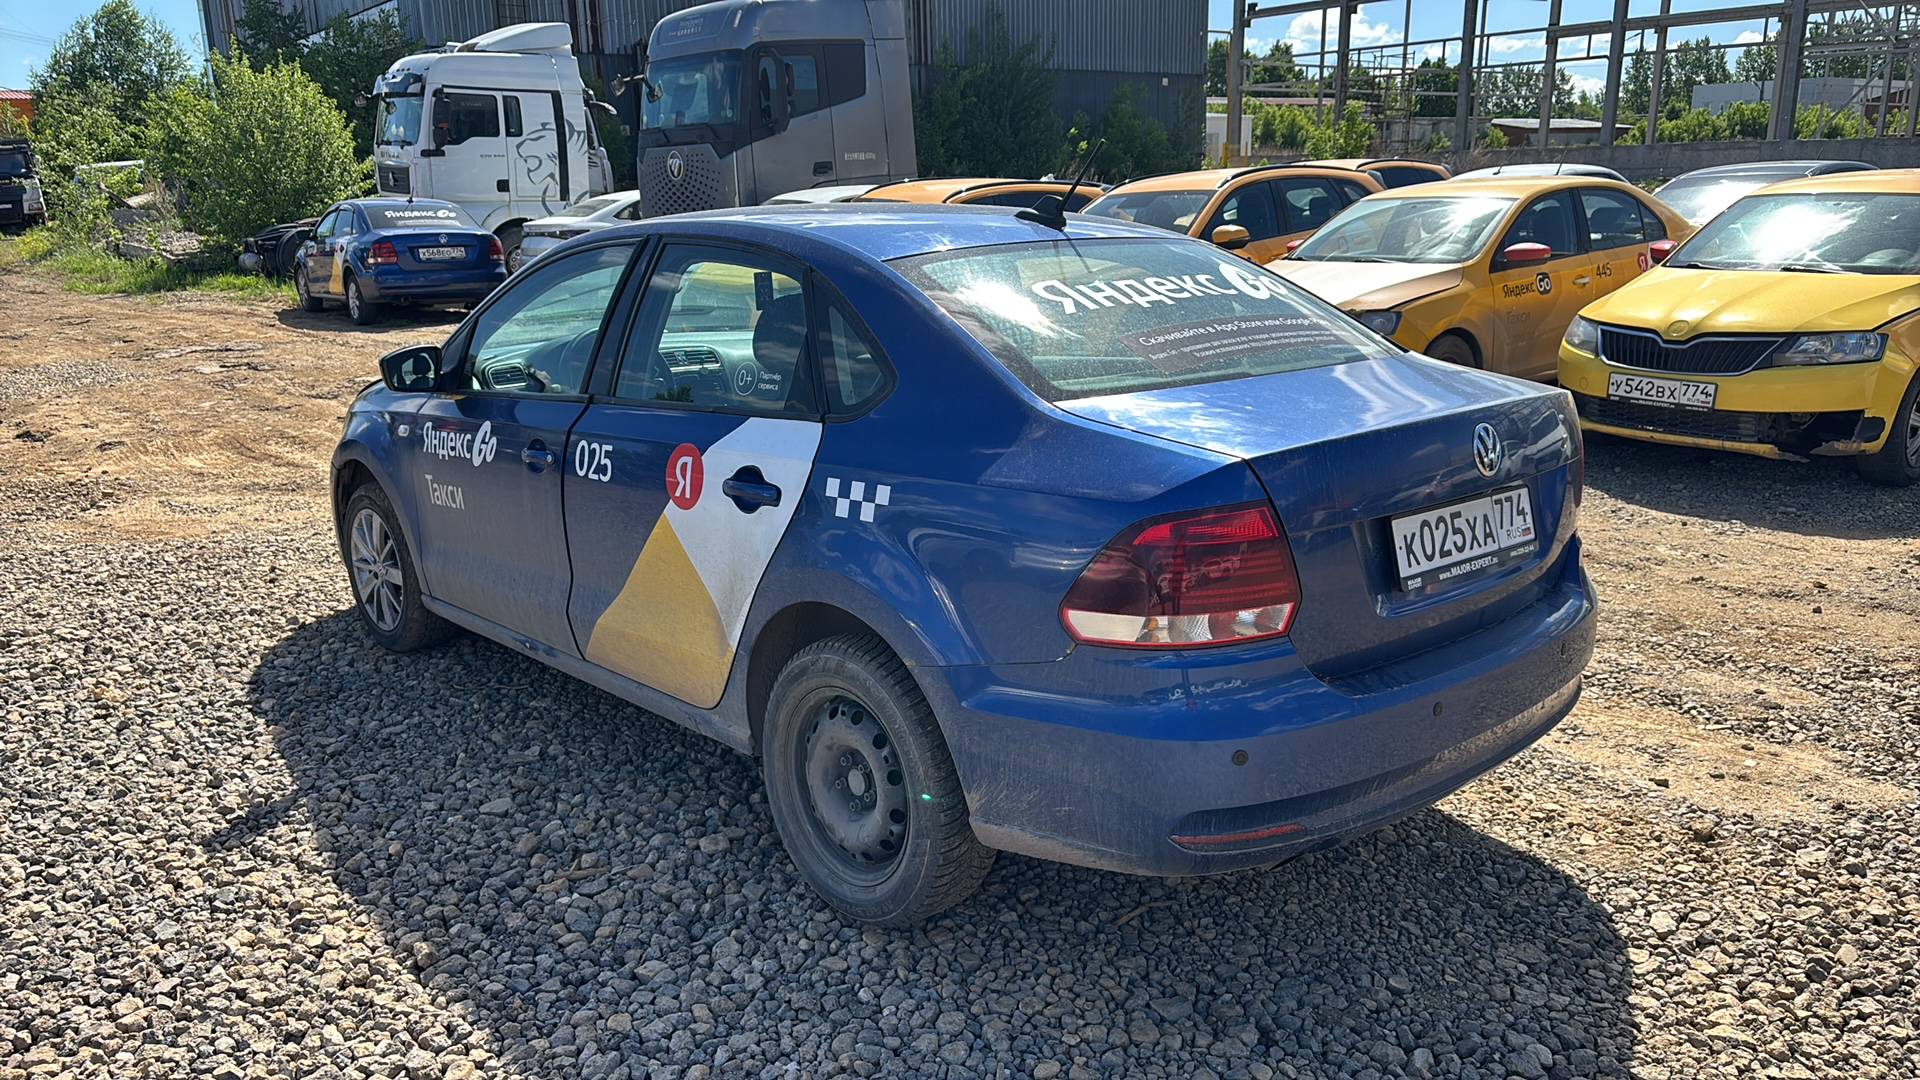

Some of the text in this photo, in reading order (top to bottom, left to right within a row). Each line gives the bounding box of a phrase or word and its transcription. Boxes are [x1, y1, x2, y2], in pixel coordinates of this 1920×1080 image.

[1502, 273, 1552, 298] Яндекс Go
[1595, 262, 1612, 278] 445
[1031, 263, 1289, 315] Яндекс Go
[1682, 384, 1709, 398] 774
[423, 420, 498, 467] Яндекс Go
[575, 439, 614, 482] 025
[425, 474, 464, 510] Такси
[1403, 493, 1527, 569] К025ХА 774
[1506, 527, 1522, 541] RUS
